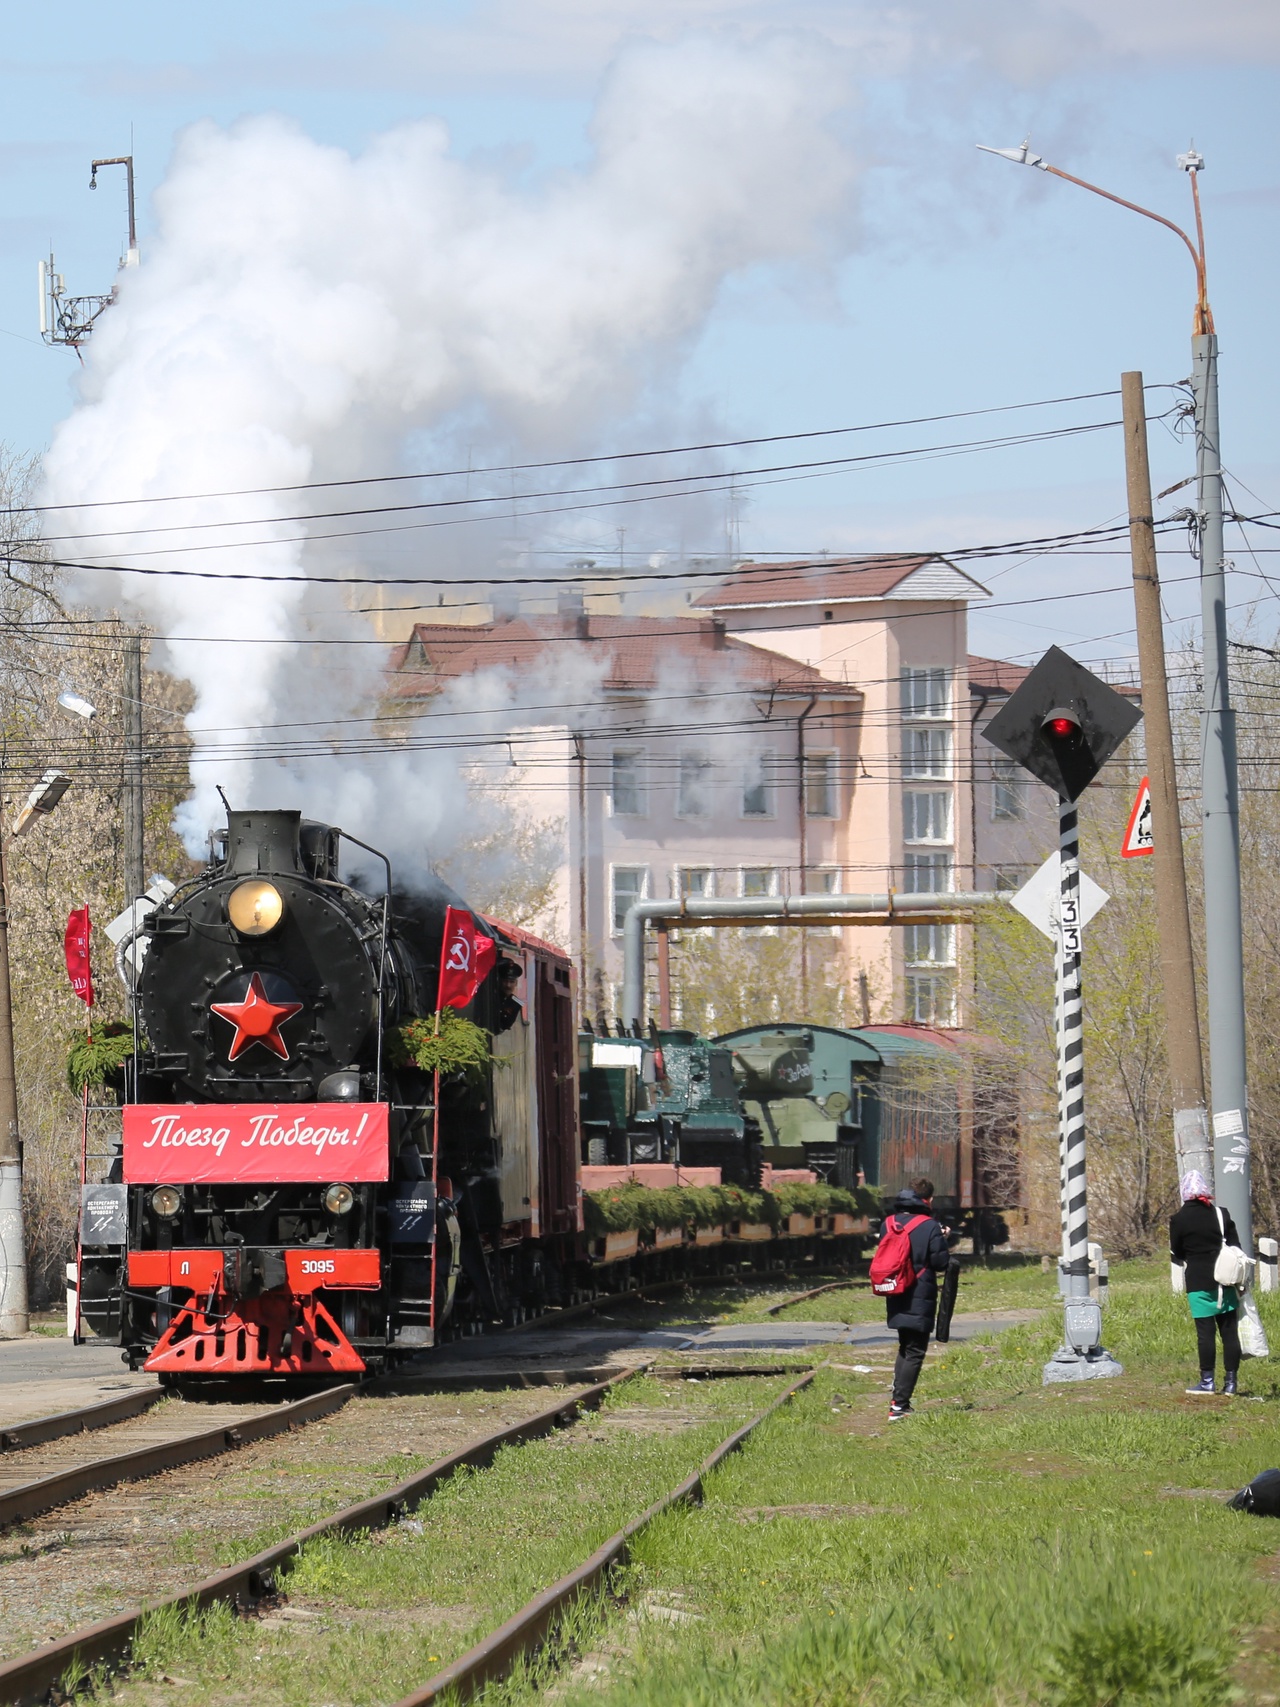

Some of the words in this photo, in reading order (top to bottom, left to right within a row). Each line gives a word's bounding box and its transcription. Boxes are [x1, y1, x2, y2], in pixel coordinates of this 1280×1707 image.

[1061, 900, 1079, 950] 33
[142, 1114, 231, 1157] Поезд
[241, 1112, 369, 1156] Победы!
[180, 1261, 190, 1275] Л
[301, 1260, 335, 1274] 3095
